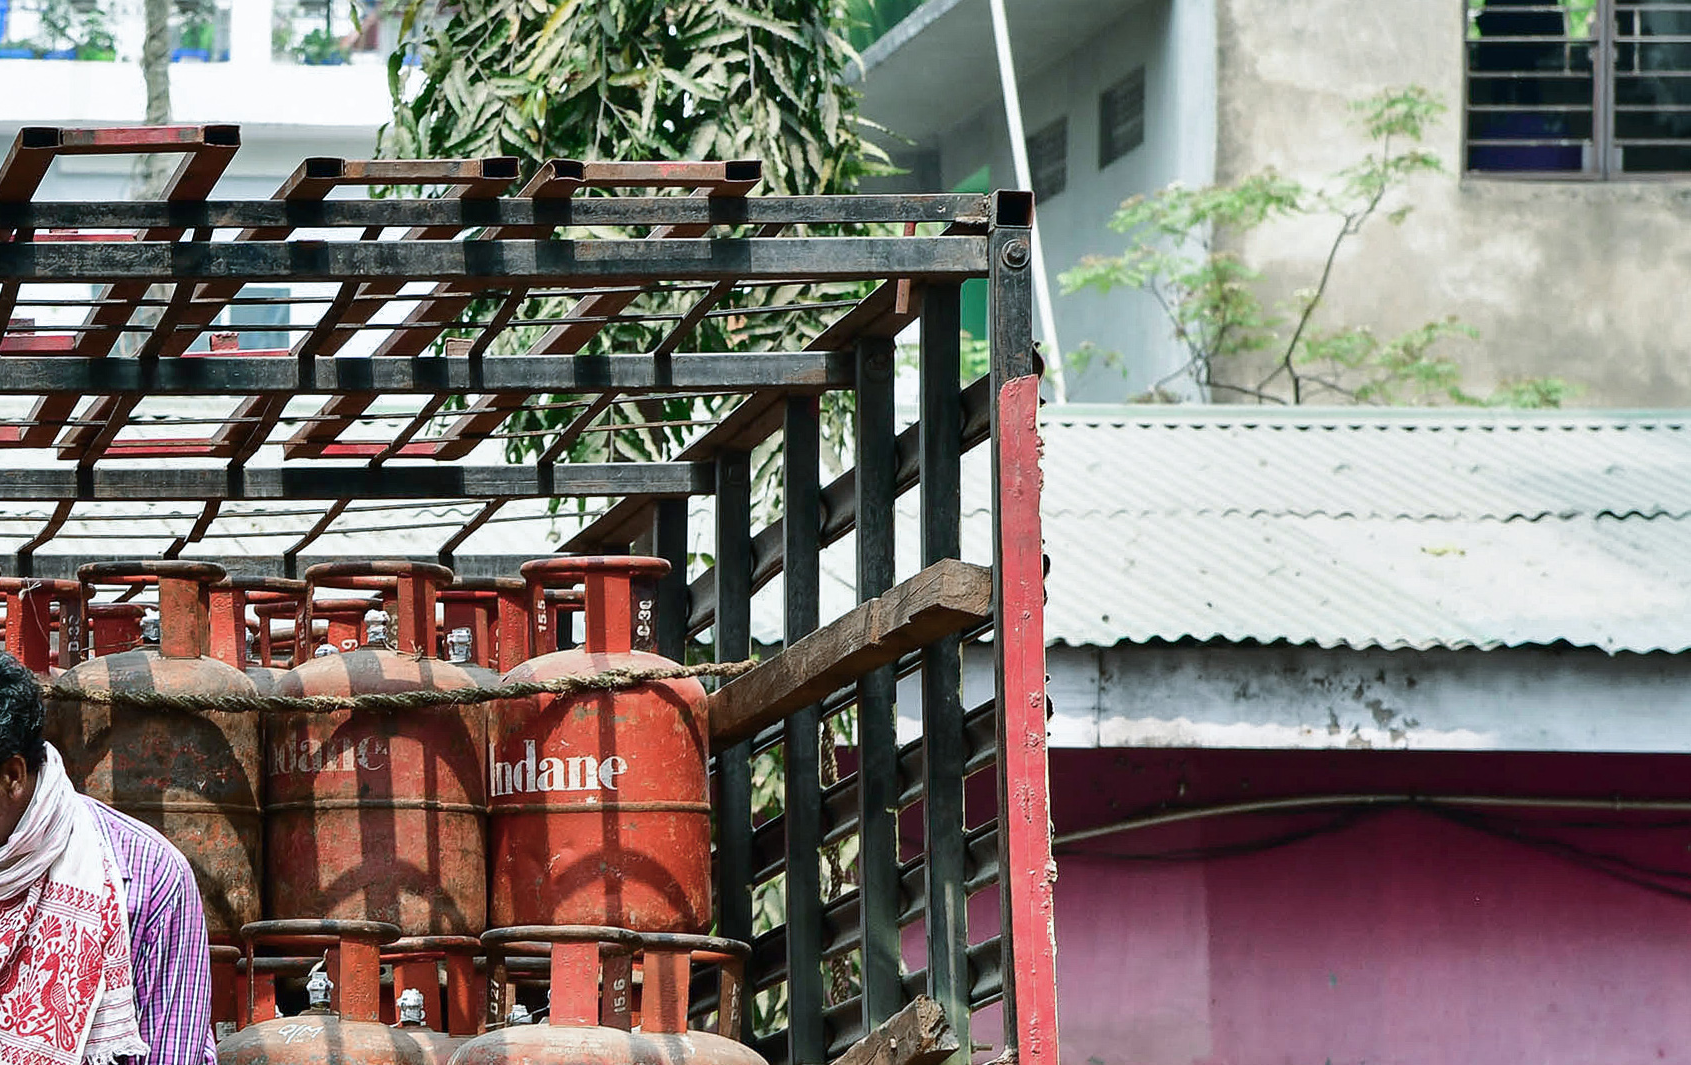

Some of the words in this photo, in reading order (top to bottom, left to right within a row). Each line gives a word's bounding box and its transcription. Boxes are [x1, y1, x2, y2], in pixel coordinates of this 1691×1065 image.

[537, 599, 548, 633] 15.5
[489, 739, 628, 798] Indane
[613, 977, 627, 1013] 15.6
